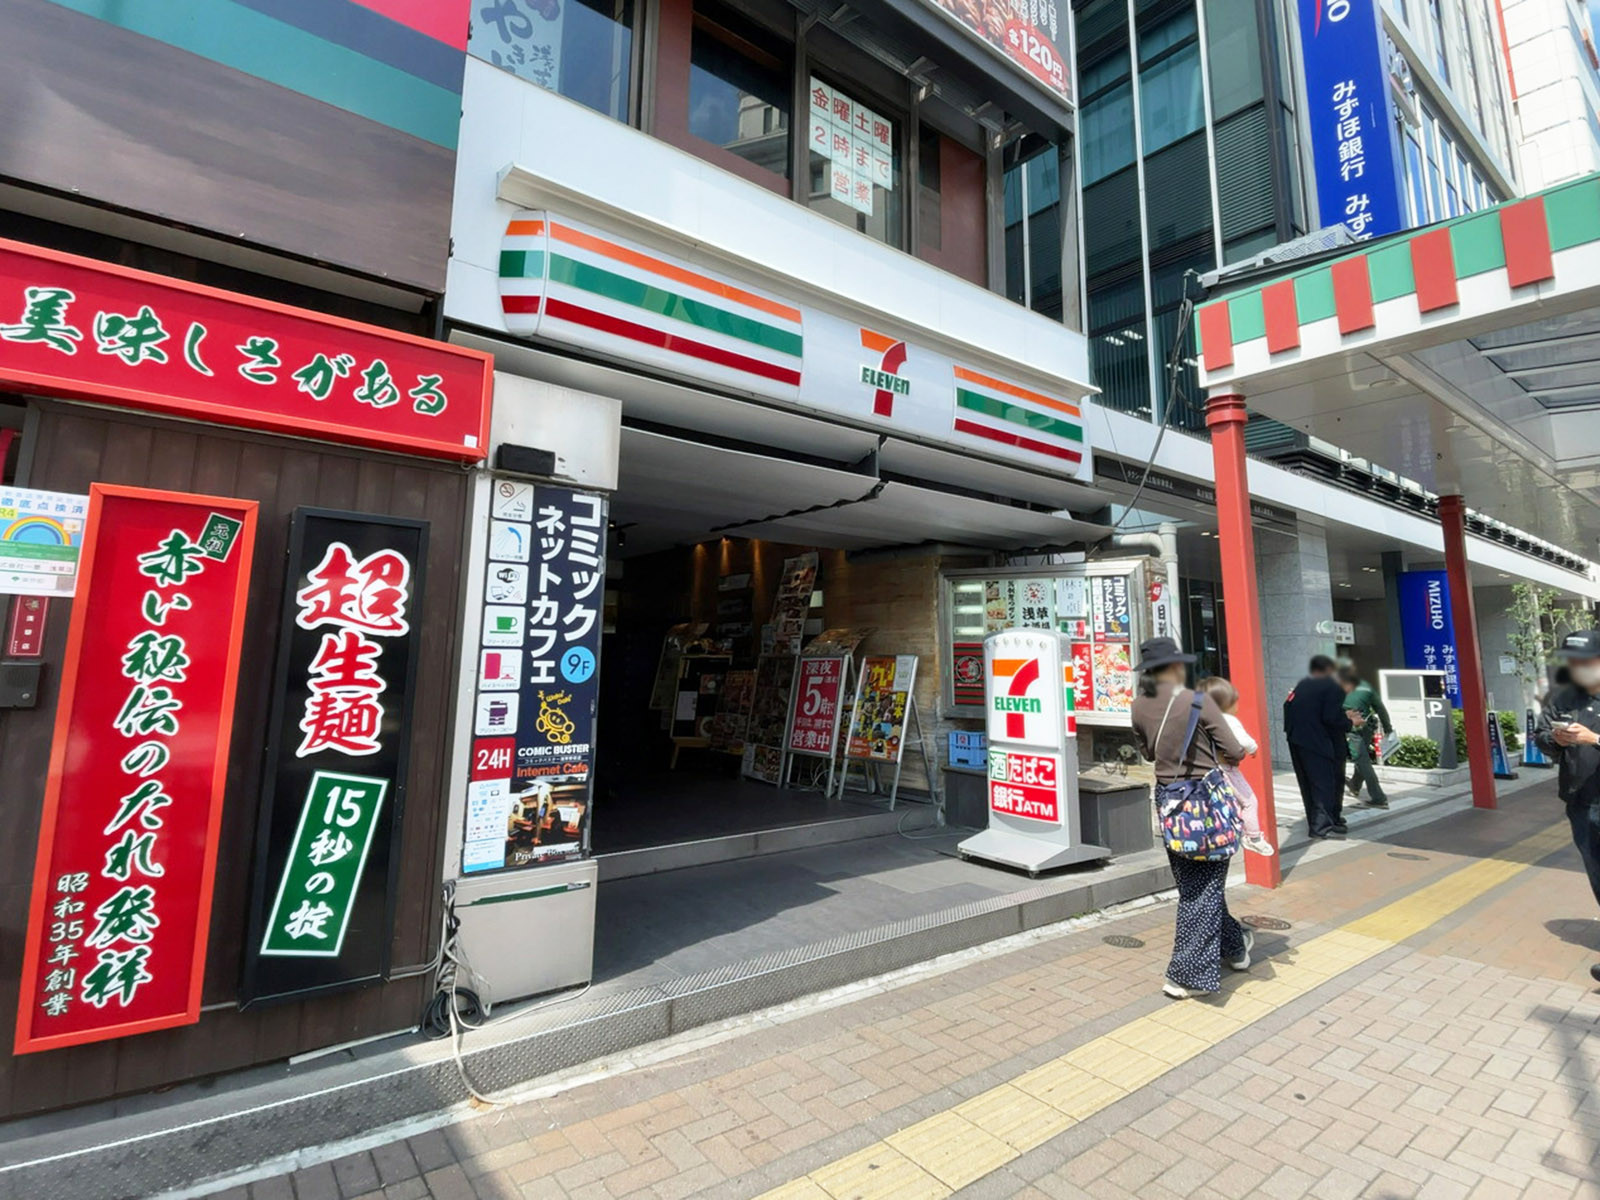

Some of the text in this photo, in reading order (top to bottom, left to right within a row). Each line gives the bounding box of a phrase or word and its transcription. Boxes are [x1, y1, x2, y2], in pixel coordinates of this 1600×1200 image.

[812, 87, 890, 146] 金曜土曜
[1332, 80, 1366, 181] みずほ銀行
[815, 126, 890, 179] 2時まで
[833, 170, 871, 205] 営業
[0, 286, 448, 416] 美味しさがある
[562, 493, 602, 642] コミック
[529, 505, 566, 683] ネットカフェ
[1022, 607, 1049, 620] 浅草
[1427, 580, 1444, 630] MIZUHO
[295, 541, 411, 758] 超生麺
[567, 653, 590, 676] 9F
[806, 660, 833, 675] 深夜
[1429, 701, 1443, 717] P
[477, 748, 511, 770] 24H
[517, 743, 590, 757] COMIC BUSTER
[792, 729, 830, 749] 営業中
[80, 528, 207, 1008] 赤い秘伝のたれ発祥
[516, 764, 561, 778] Internet
[989, 753, 1056, 786] 酒 たばこ
[993, 786, 1054, 817] 銀行ATM
[283, 785, 367, 940] 15秒の掟
[41, 872, 90, 1016] 昭和35年創業
